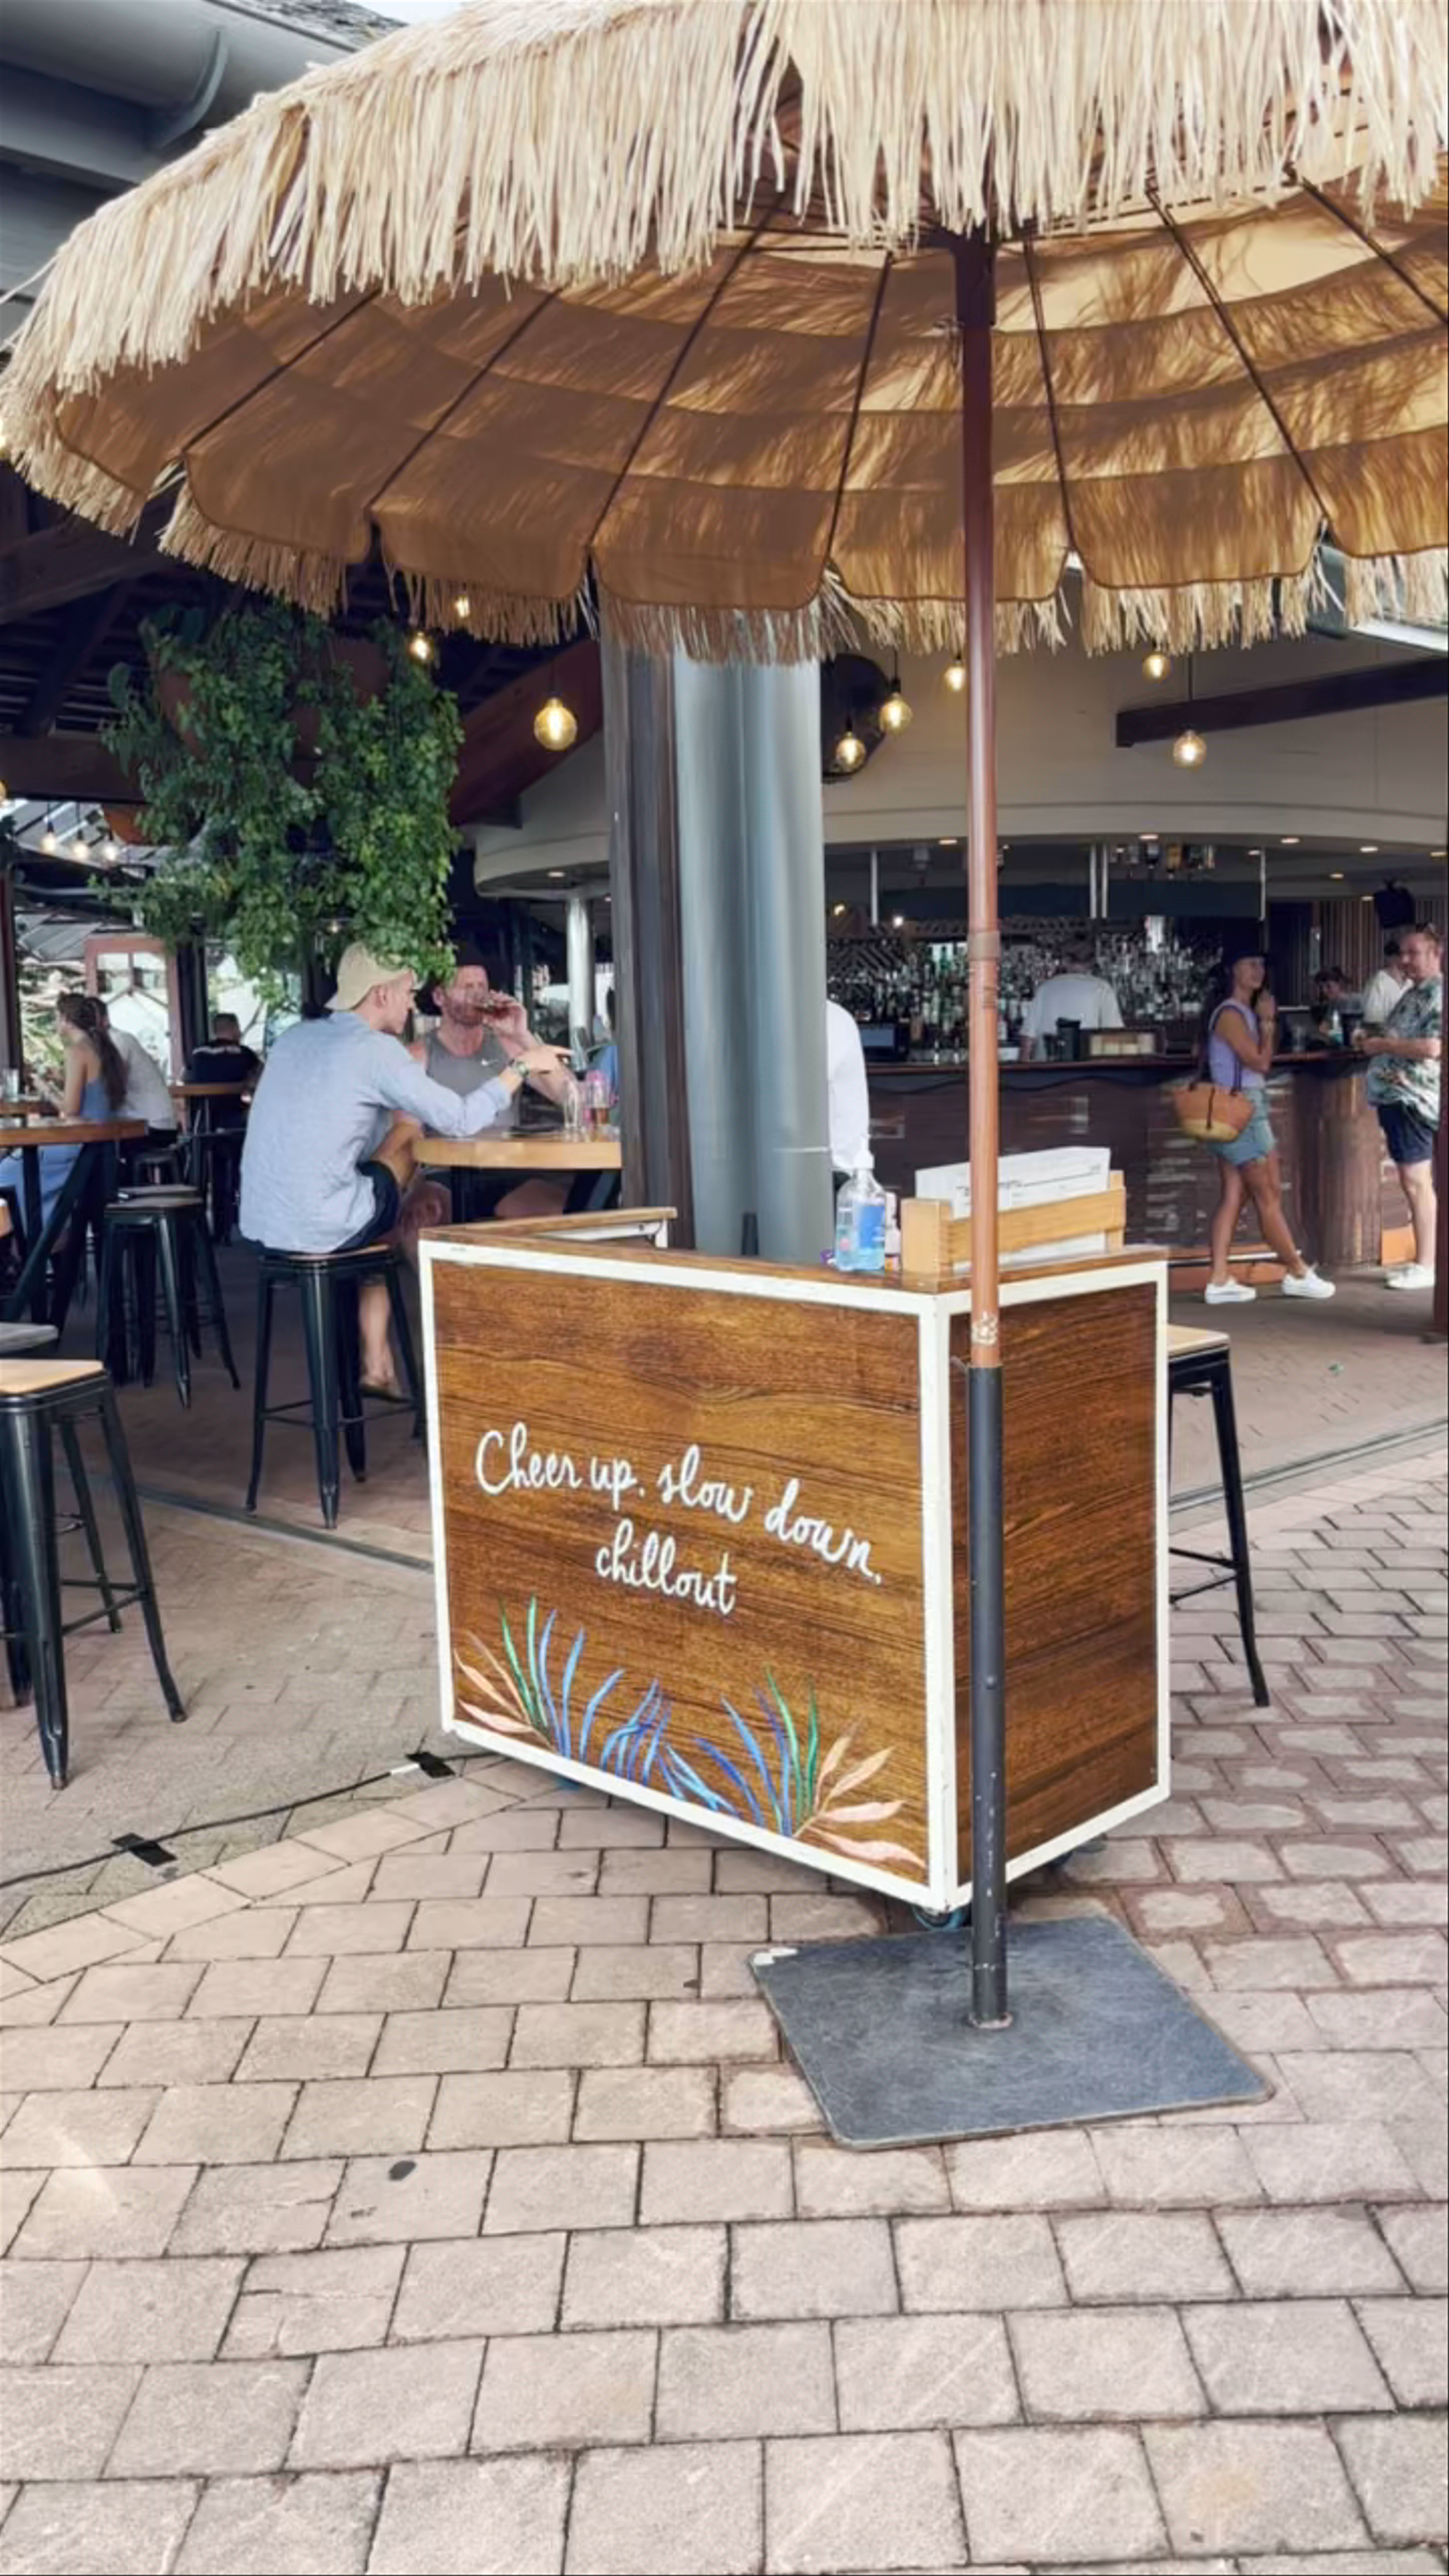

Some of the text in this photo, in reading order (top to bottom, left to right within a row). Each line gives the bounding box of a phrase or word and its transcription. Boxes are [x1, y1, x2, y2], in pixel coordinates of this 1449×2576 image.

[475, 1421, 583, 1495] Cheer
[656, 1444, 754, 1523] slow
[595, 1518, 737, 1615] chillout
